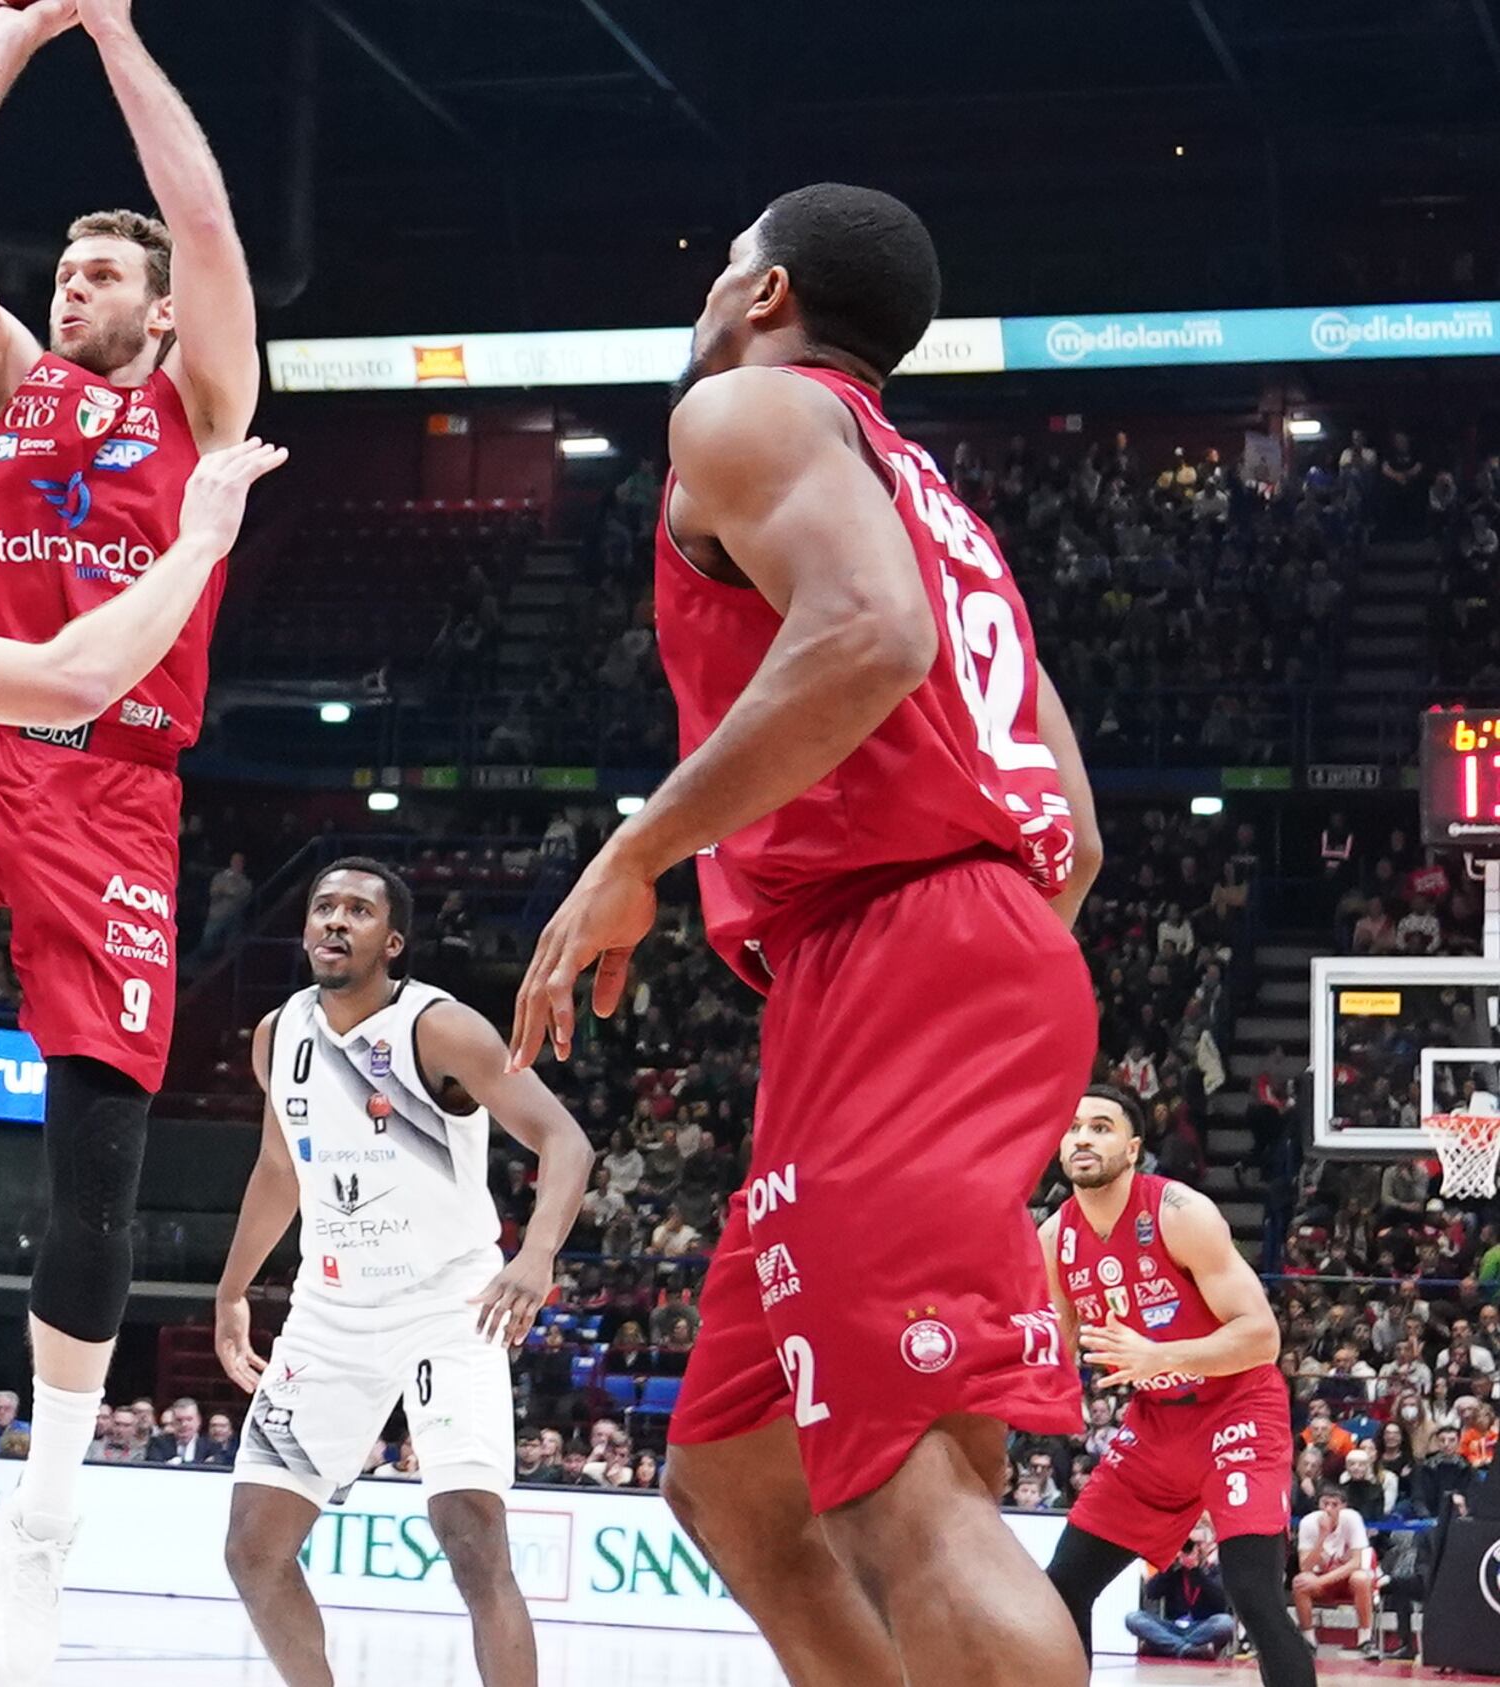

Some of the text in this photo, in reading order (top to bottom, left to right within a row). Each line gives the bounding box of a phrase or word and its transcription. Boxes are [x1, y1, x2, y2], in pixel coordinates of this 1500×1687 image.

[1047, 320, 1224, 362] mediolanum
[1312, 312, 1494, 353] mediolanum
[514, 346, 584, 378] GUSTO
[904, 340, 973, 368] usto
[24, 366, 69, 384] A7
[20, 438, 56, 451] Group
[94, 444, 143, 468] SAP
[1455, 719, 1500, 751] 6:
[1464, 754, 1500, 818] 1
[101, 875, 169, 920] AON
[104, 943, 169, 968] EYEWEAR
[120, 978, 152, 1034] 9
[293, 1038, 314, 1084] 0
[364, 1150, 398, 1162] ASTM
[747, 1163, 797, 1234] ON
[1060, 1227, 1077, 1265] 3
[1142, 1307, 1177, 1328] SAP
[416, 1358, 432, 1407] 0
[777, 1334, 831, 1428] 2
[1211, 1420, 1258, 1453] AON
[1226, 1471, 1249, 1507] 3
[590, 1525, 733, 1600] SAN
